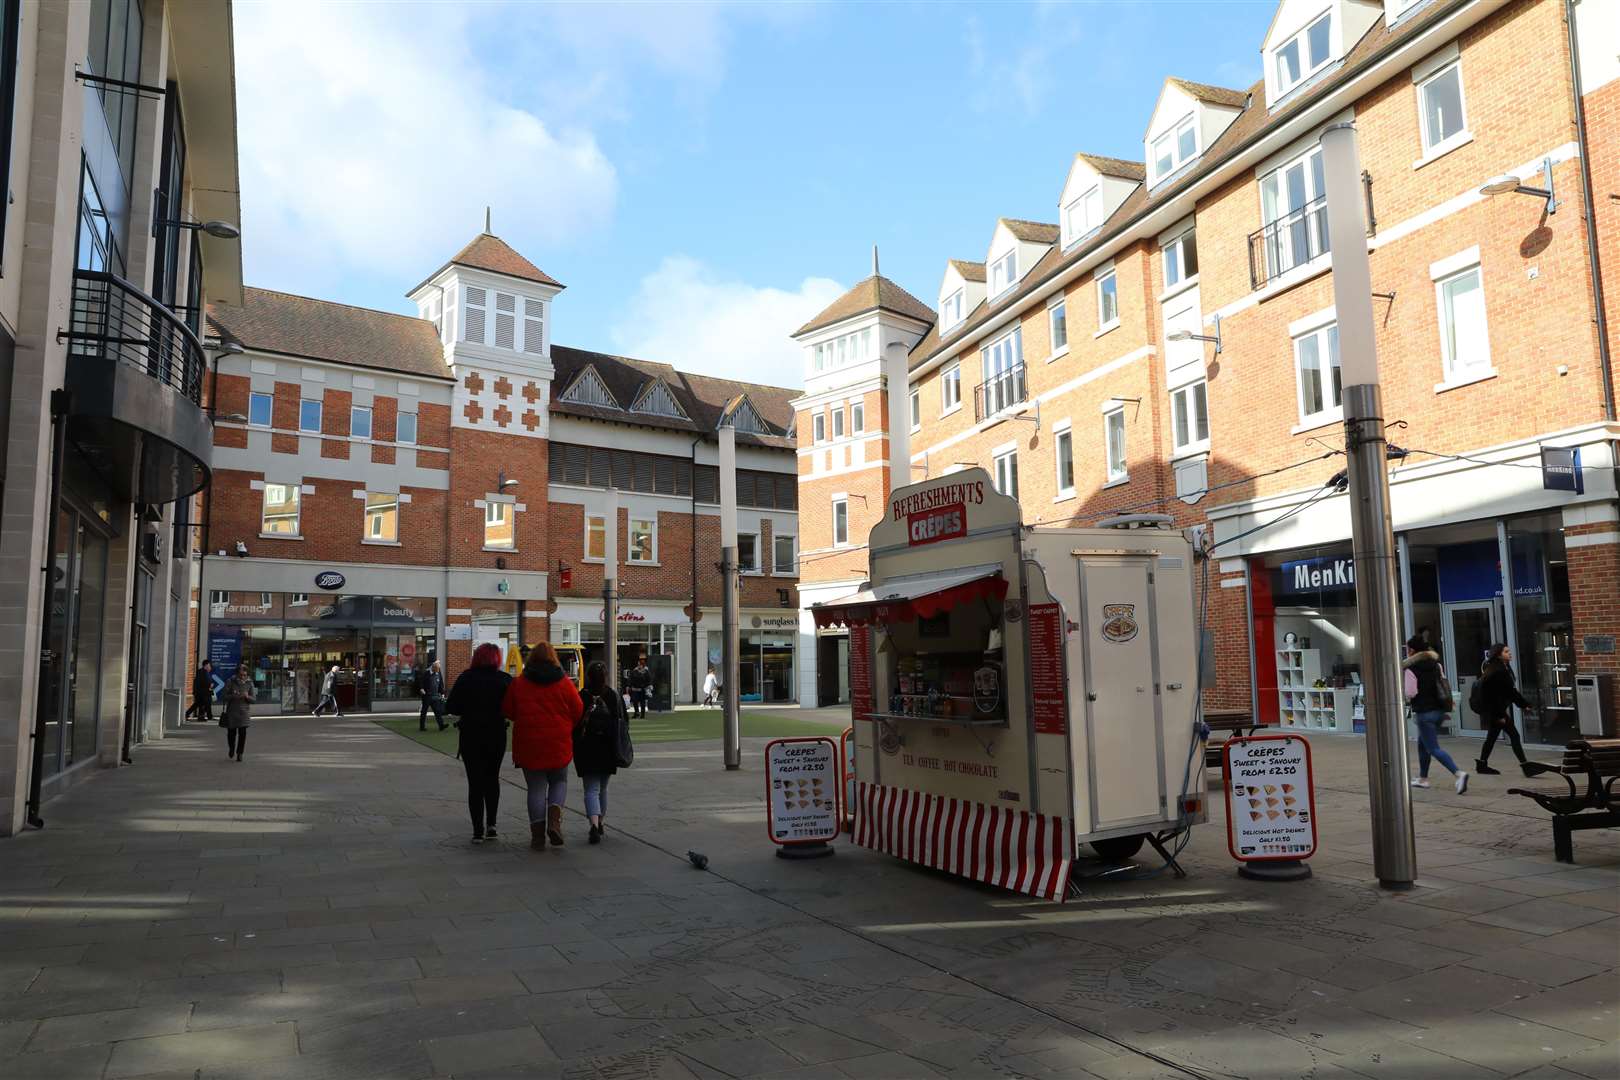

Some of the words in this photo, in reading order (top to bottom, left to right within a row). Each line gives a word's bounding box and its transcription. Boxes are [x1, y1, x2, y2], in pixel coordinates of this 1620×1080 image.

[893, 481, 983, 521] REFRESHMENTS
[911, 512, 961, 541] CRÊPES
[319, 574, 343, 586] Boots
[1295, 559, 1354, 589] MenKi
[383, 607, 413, 617] beauty
[763, 617, 793, 628] sunglass
[903, 754, 913, 766] TEA
[918, 757, 940, 769] COFFEE
[944, 760, 957, 772] HOT
[959, 761, 999, 778] CHOCOLATE
[1241, 769, 1265, 777] FROM
[1269, 766, 1297, 775] £2.50
